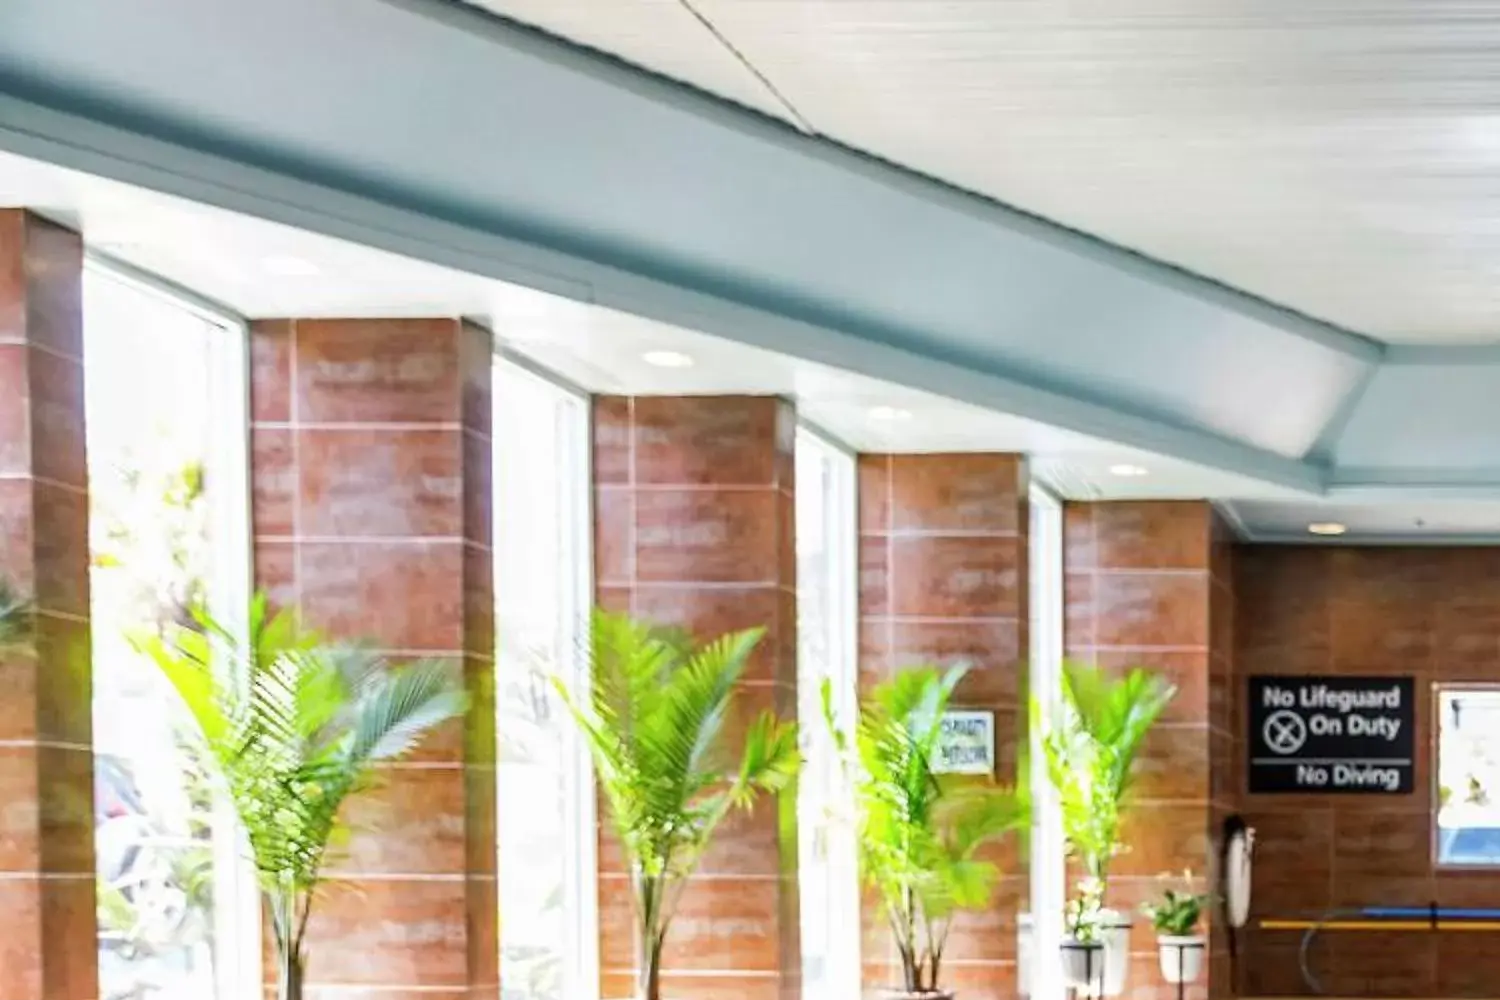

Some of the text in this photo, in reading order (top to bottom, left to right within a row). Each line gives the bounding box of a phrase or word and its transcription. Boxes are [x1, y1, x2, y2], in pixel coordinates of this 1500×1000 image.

[1263, 685, 1401, 713] No Lifeguard
[1309, 714, 1401, 741] On Duty
[1297, 763, 1400, 791] No Diving
